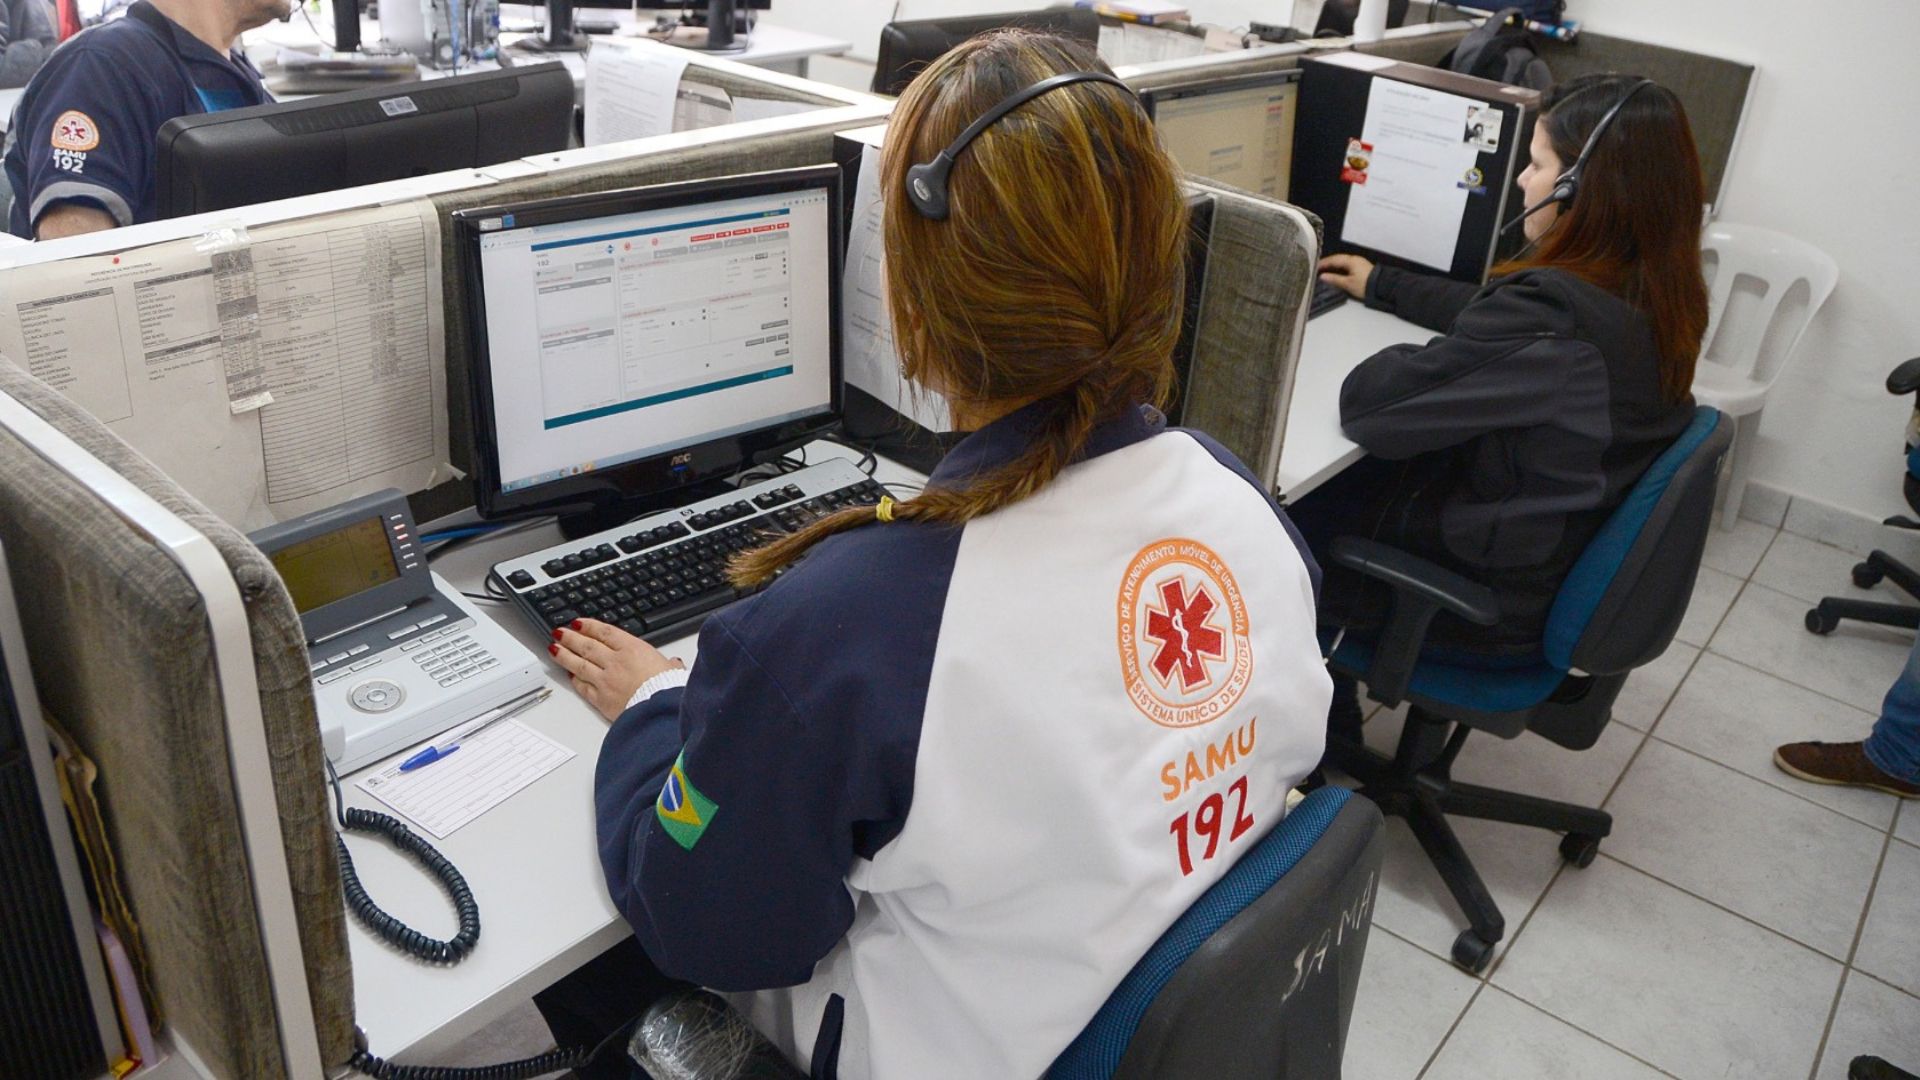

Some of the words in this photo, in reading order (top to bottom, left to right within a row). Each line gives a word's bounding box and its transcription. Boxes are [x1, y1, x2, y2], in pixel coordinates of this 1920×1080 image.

[53, 155, 83, 174] 192
[54, 149, 87, 161] SAMU
[1123, 546, 1175, 602] ATENDIMENTO
[1210, 559, 1224, 576] DE
[1121, 603, 1130, 619] DE
[1132, 682, 1174, 722] SISTEMA
[1220, 686, 1238, 706] DE
[1160, 715, 1257, 802] SAMU
[1169, 774, 1255, 877] 192
